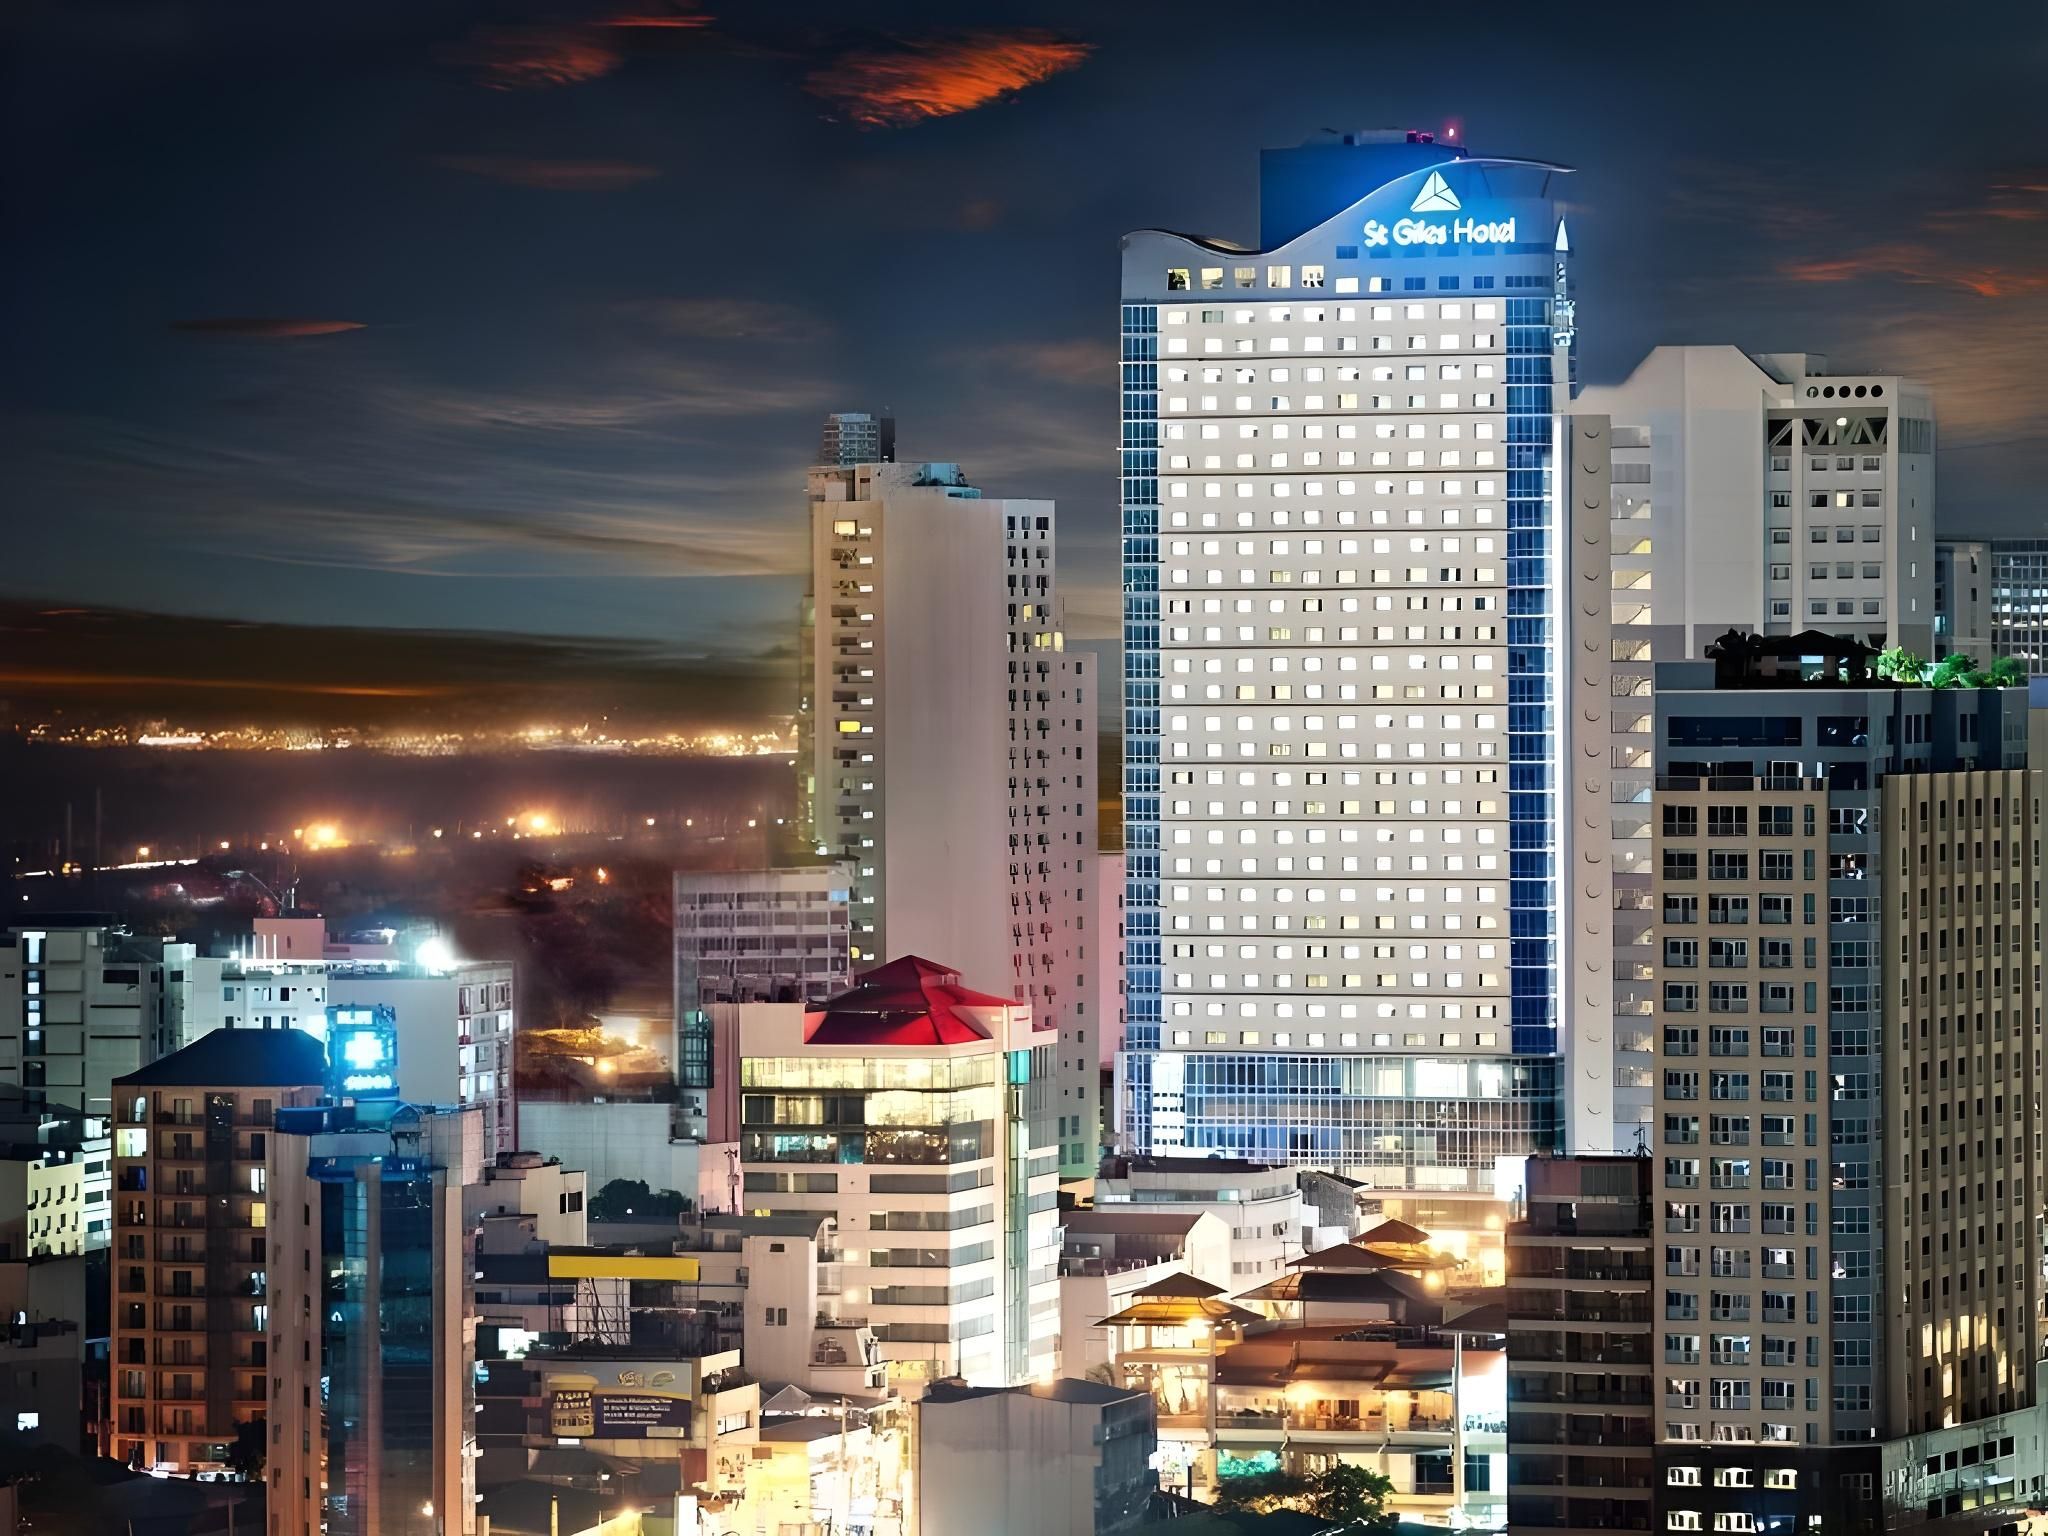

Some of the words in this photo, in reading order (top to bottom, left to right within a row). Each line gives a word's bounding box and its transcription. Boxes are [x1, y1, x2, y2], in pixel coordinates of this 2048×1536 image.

[1363, 219, 1388, 247] St
[1392, 218, 1447, 245] Giles
[1453, 217, 1516, 243] Hotel
